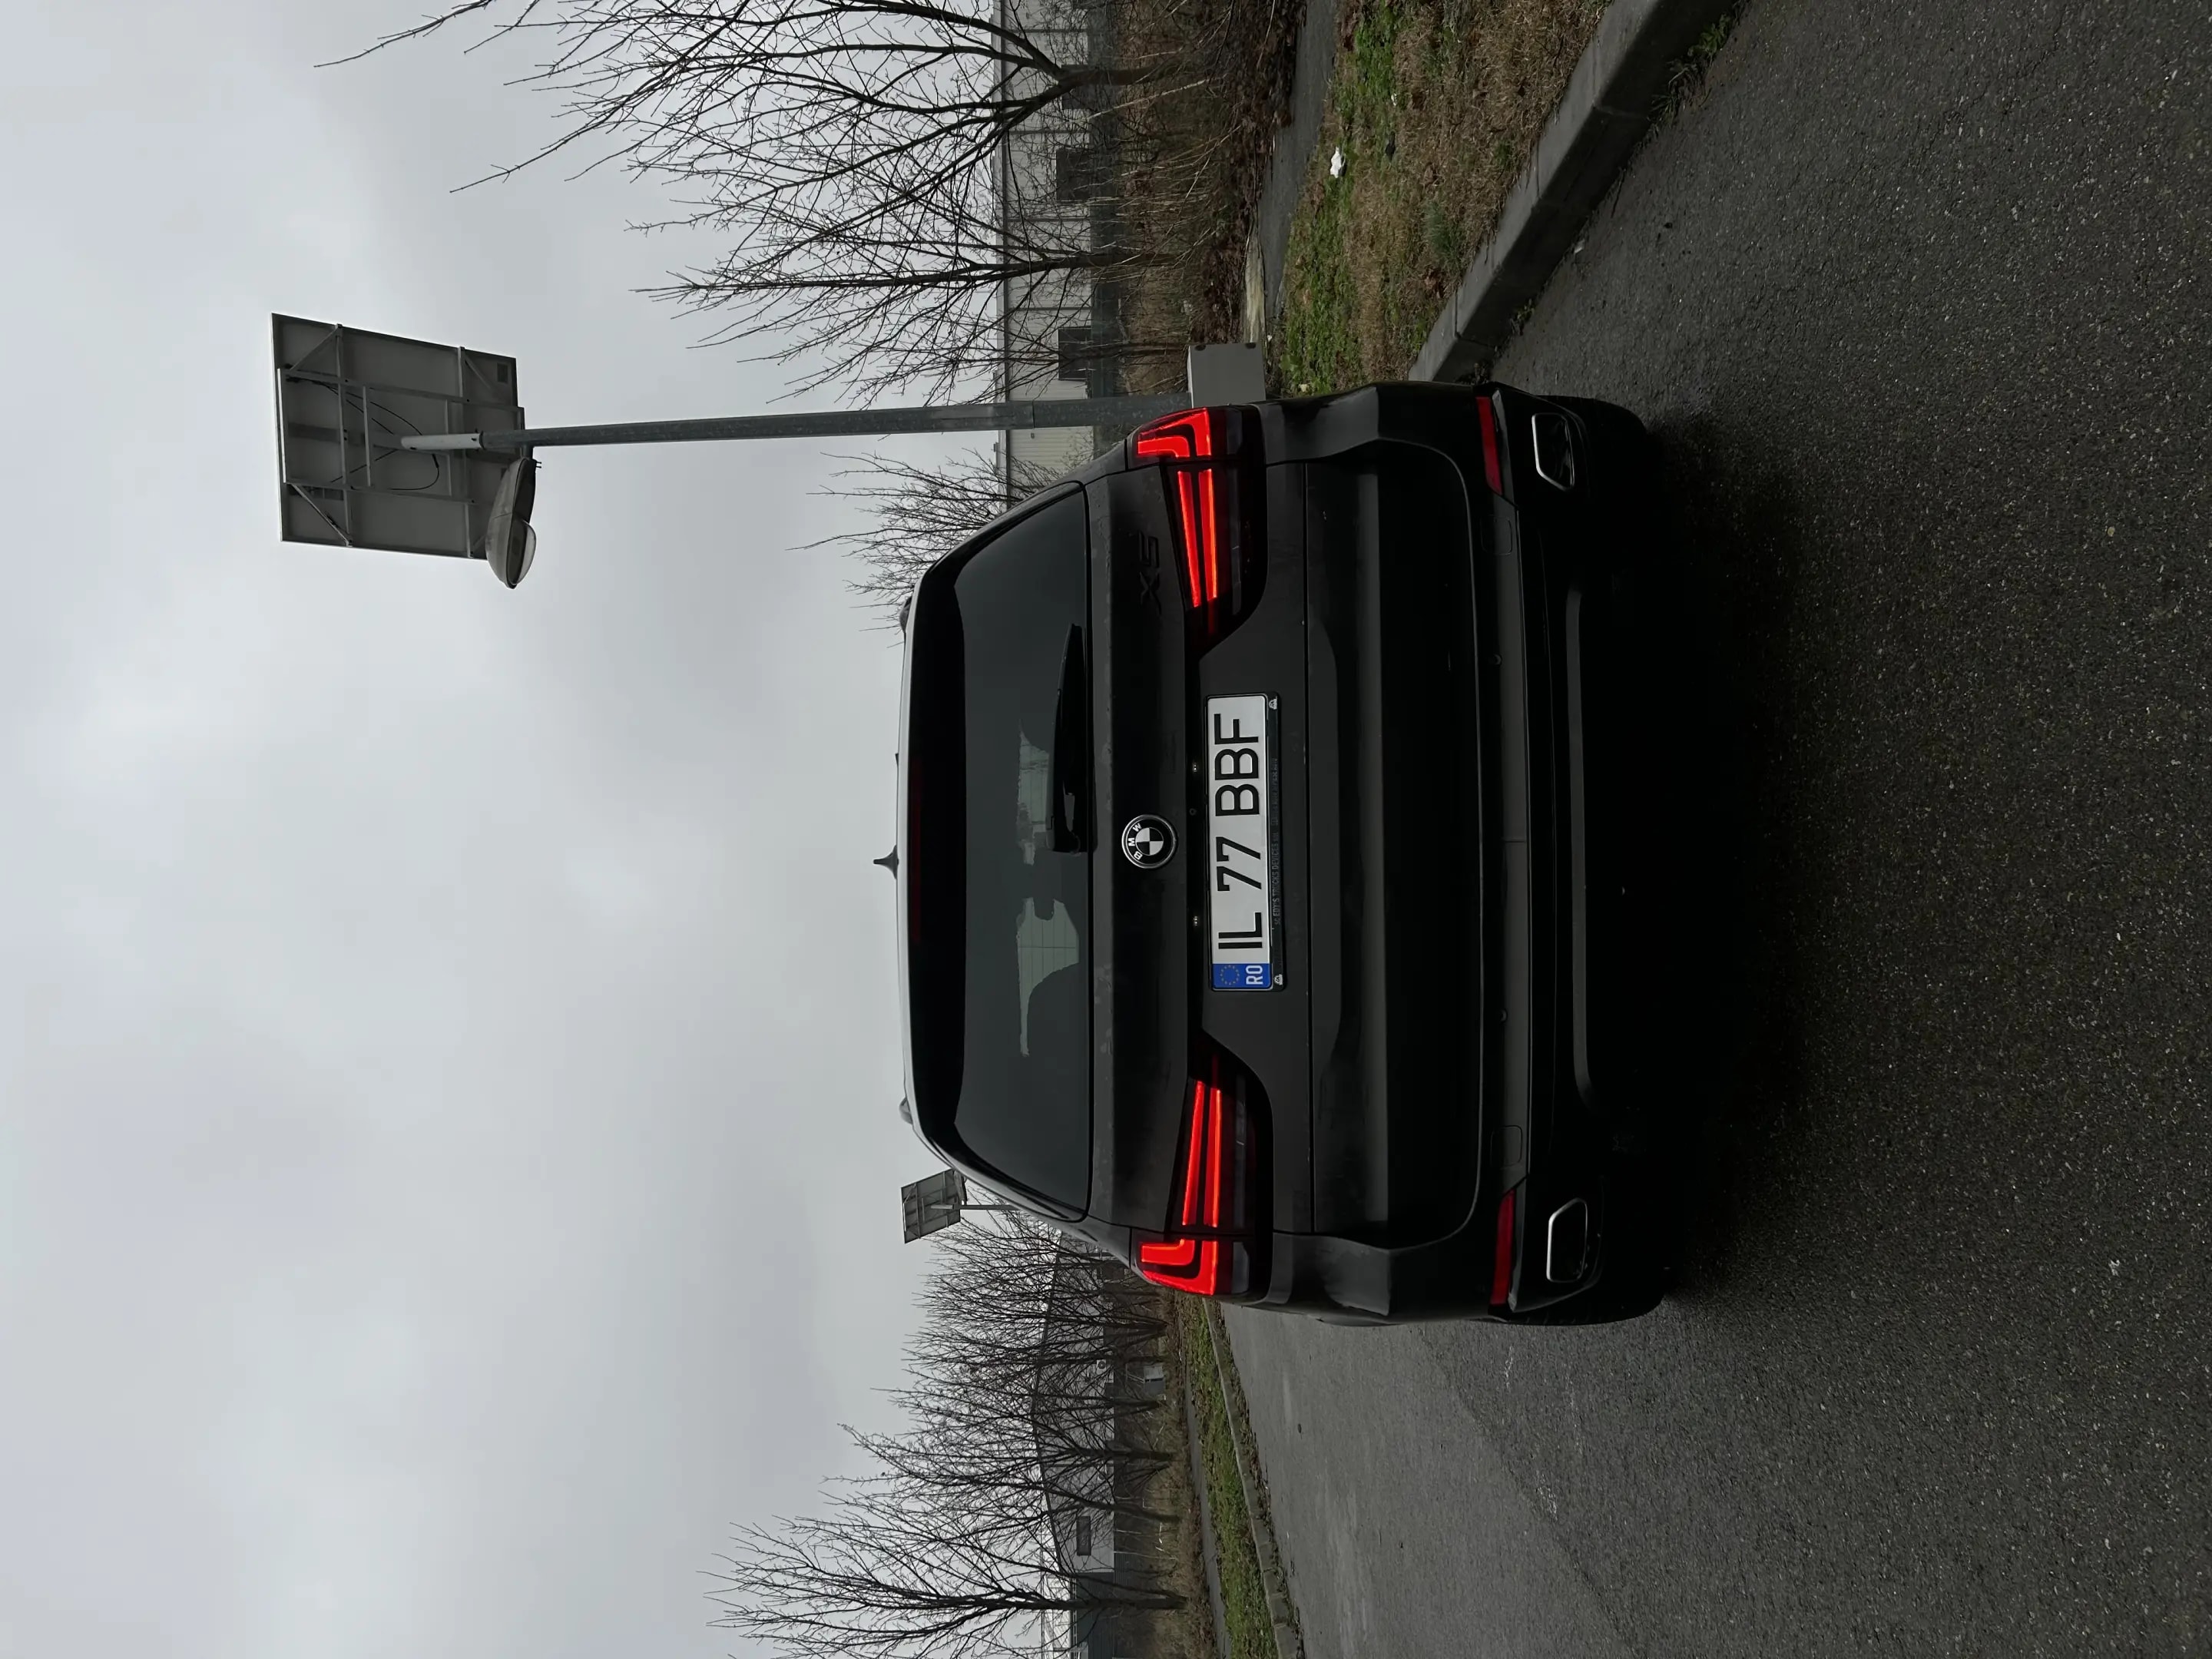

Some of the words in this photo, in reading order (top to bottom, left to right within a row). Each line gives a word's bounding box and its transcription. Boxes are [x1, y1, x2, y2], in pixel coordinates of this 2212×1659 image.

[1138, 531, 1161, 616] X5
[1214, 714, 1260, 817] BBF
[1128, 823, 1143, 860] BMW
[1215, 836, 1262, 892] 77
[1272, 897, 1280, 916] EDY'S
[1217, 912, 1263, 950] IL
[1245, 965, 1263, 985] RO
